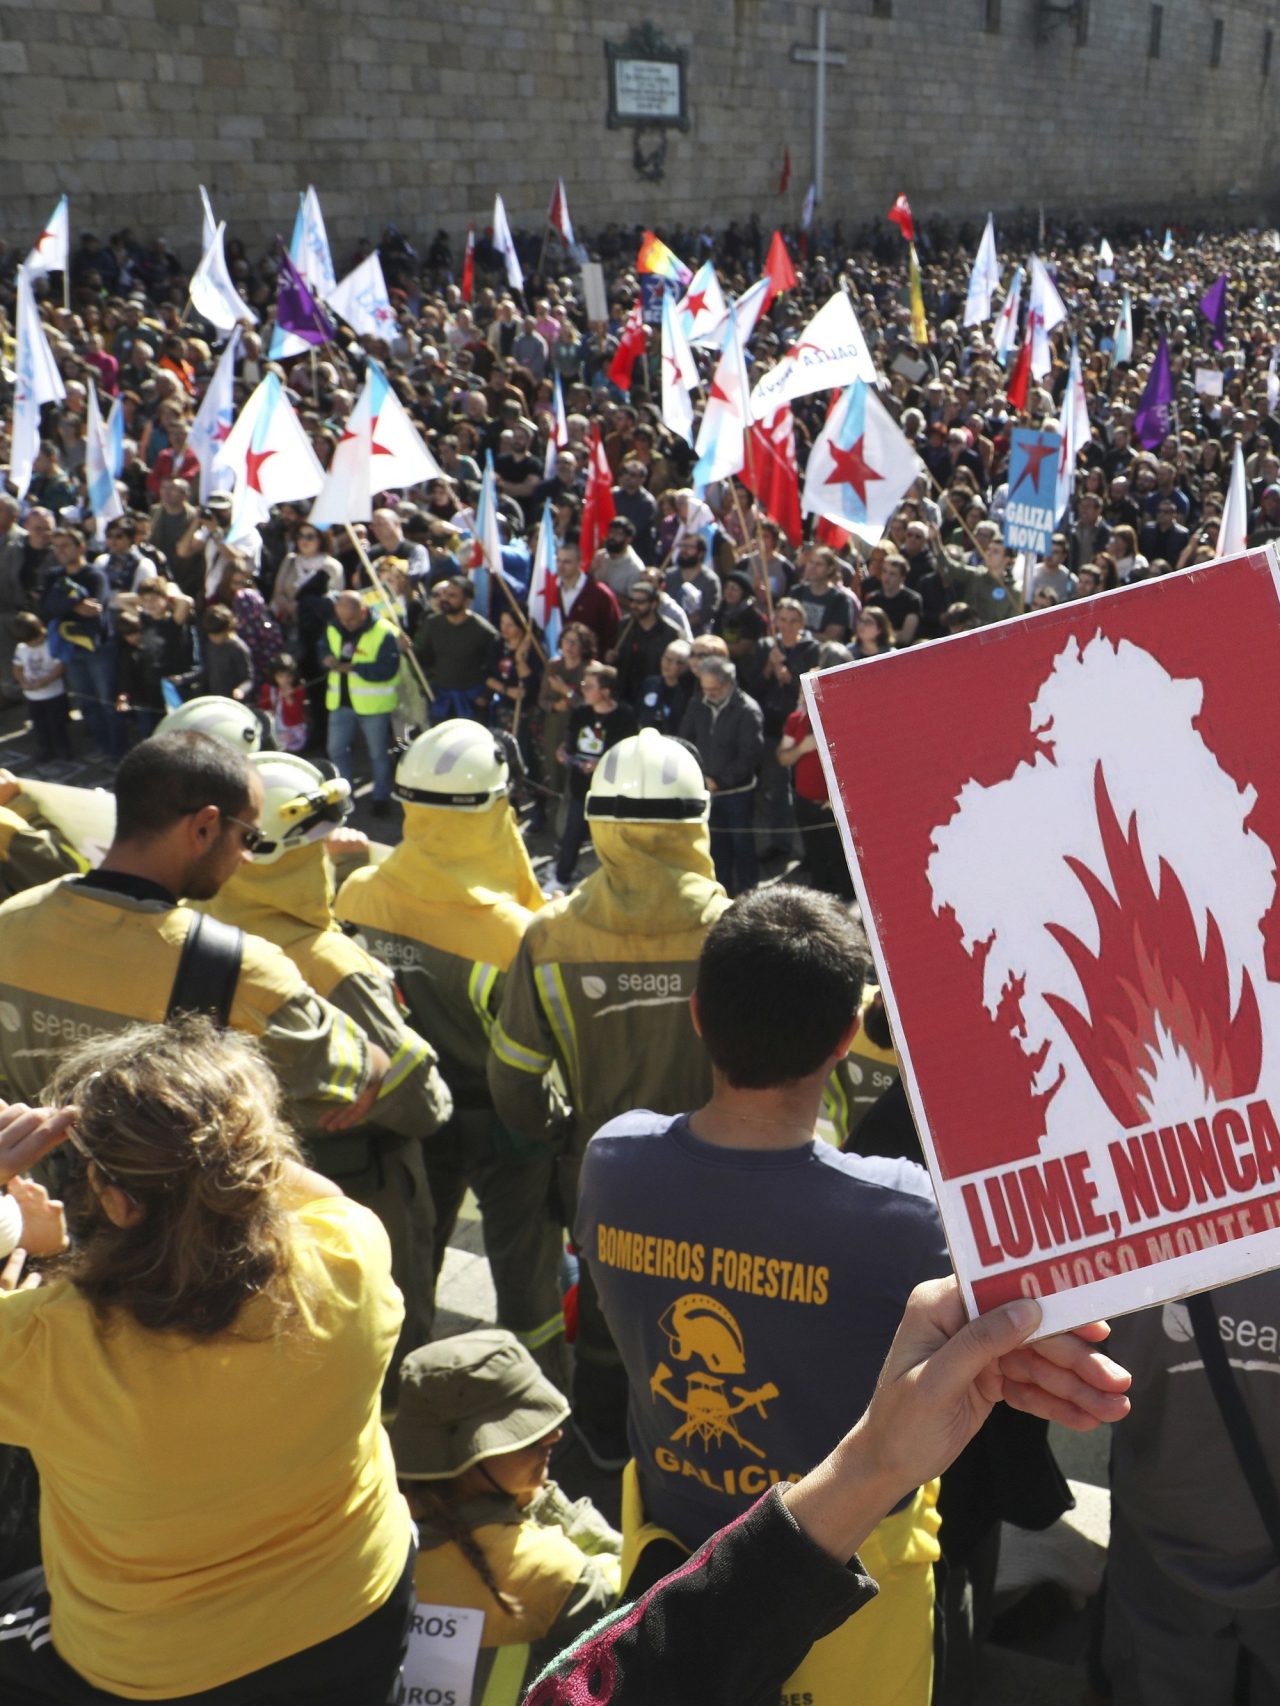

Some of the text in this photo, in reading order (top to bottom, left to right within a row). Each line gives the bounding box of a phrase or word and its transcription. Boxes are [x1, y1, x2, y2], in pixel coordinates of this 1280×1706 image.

[1007, 501, 1053, 533] GALIZA
[1008, 525, 1046, 553] NOVA
[617, 973, 682, 997] seaga
[960, 1150, 1122, 1267] LUME,
[597, 1223, 830, 1305] BOMBEIROS FORESTAIS
[654, 1446, 804, 1496] GALICI
